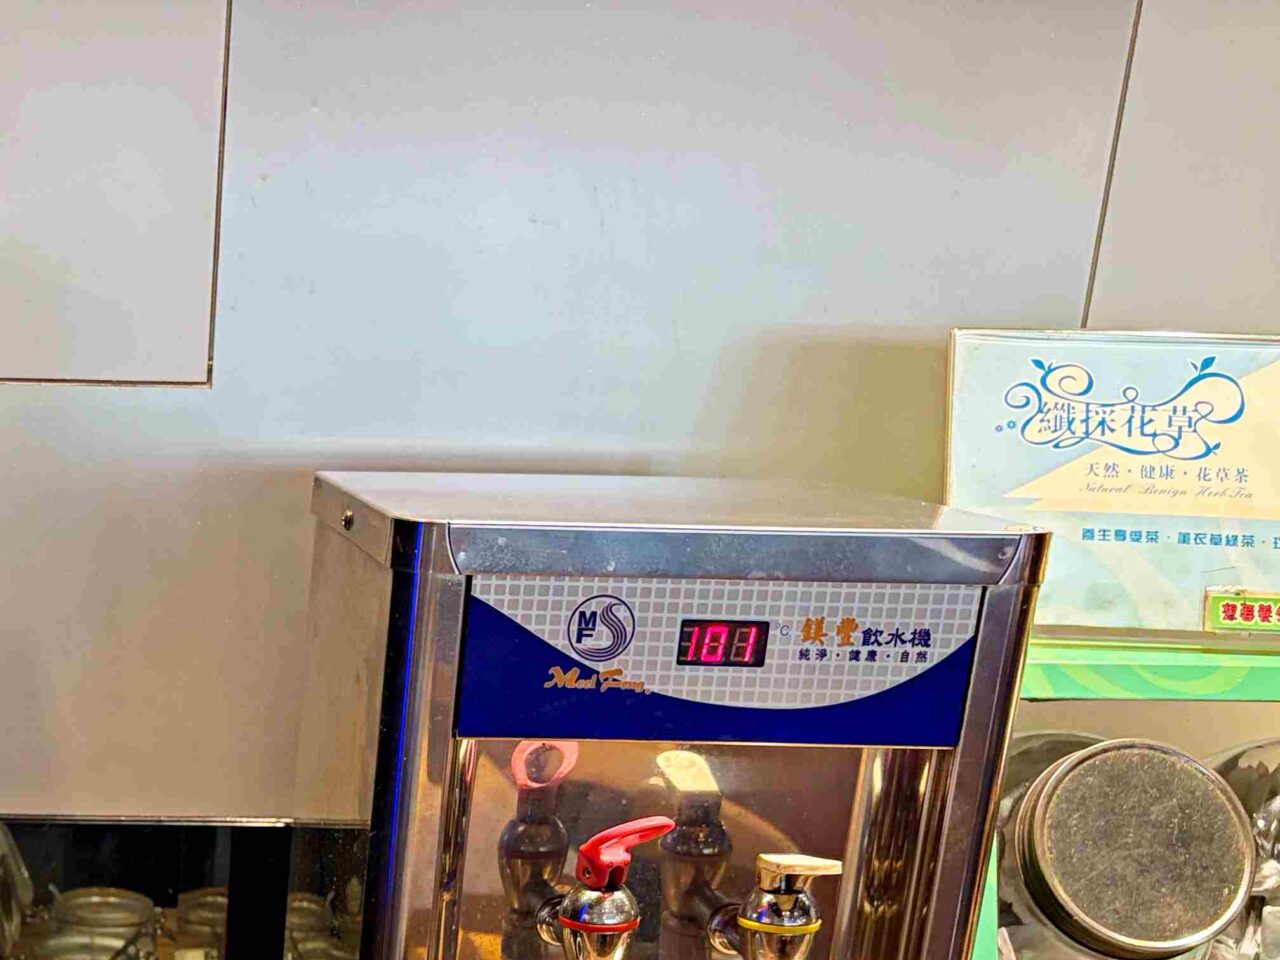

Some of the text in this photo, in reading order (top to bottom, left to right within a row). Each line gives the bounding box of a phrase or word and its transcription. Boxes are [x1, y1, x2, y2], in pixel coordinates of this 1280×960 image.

[1079, 482, 1254, 499] Natural Benign Herb Tea
[686, 622, 758, 663] 101
